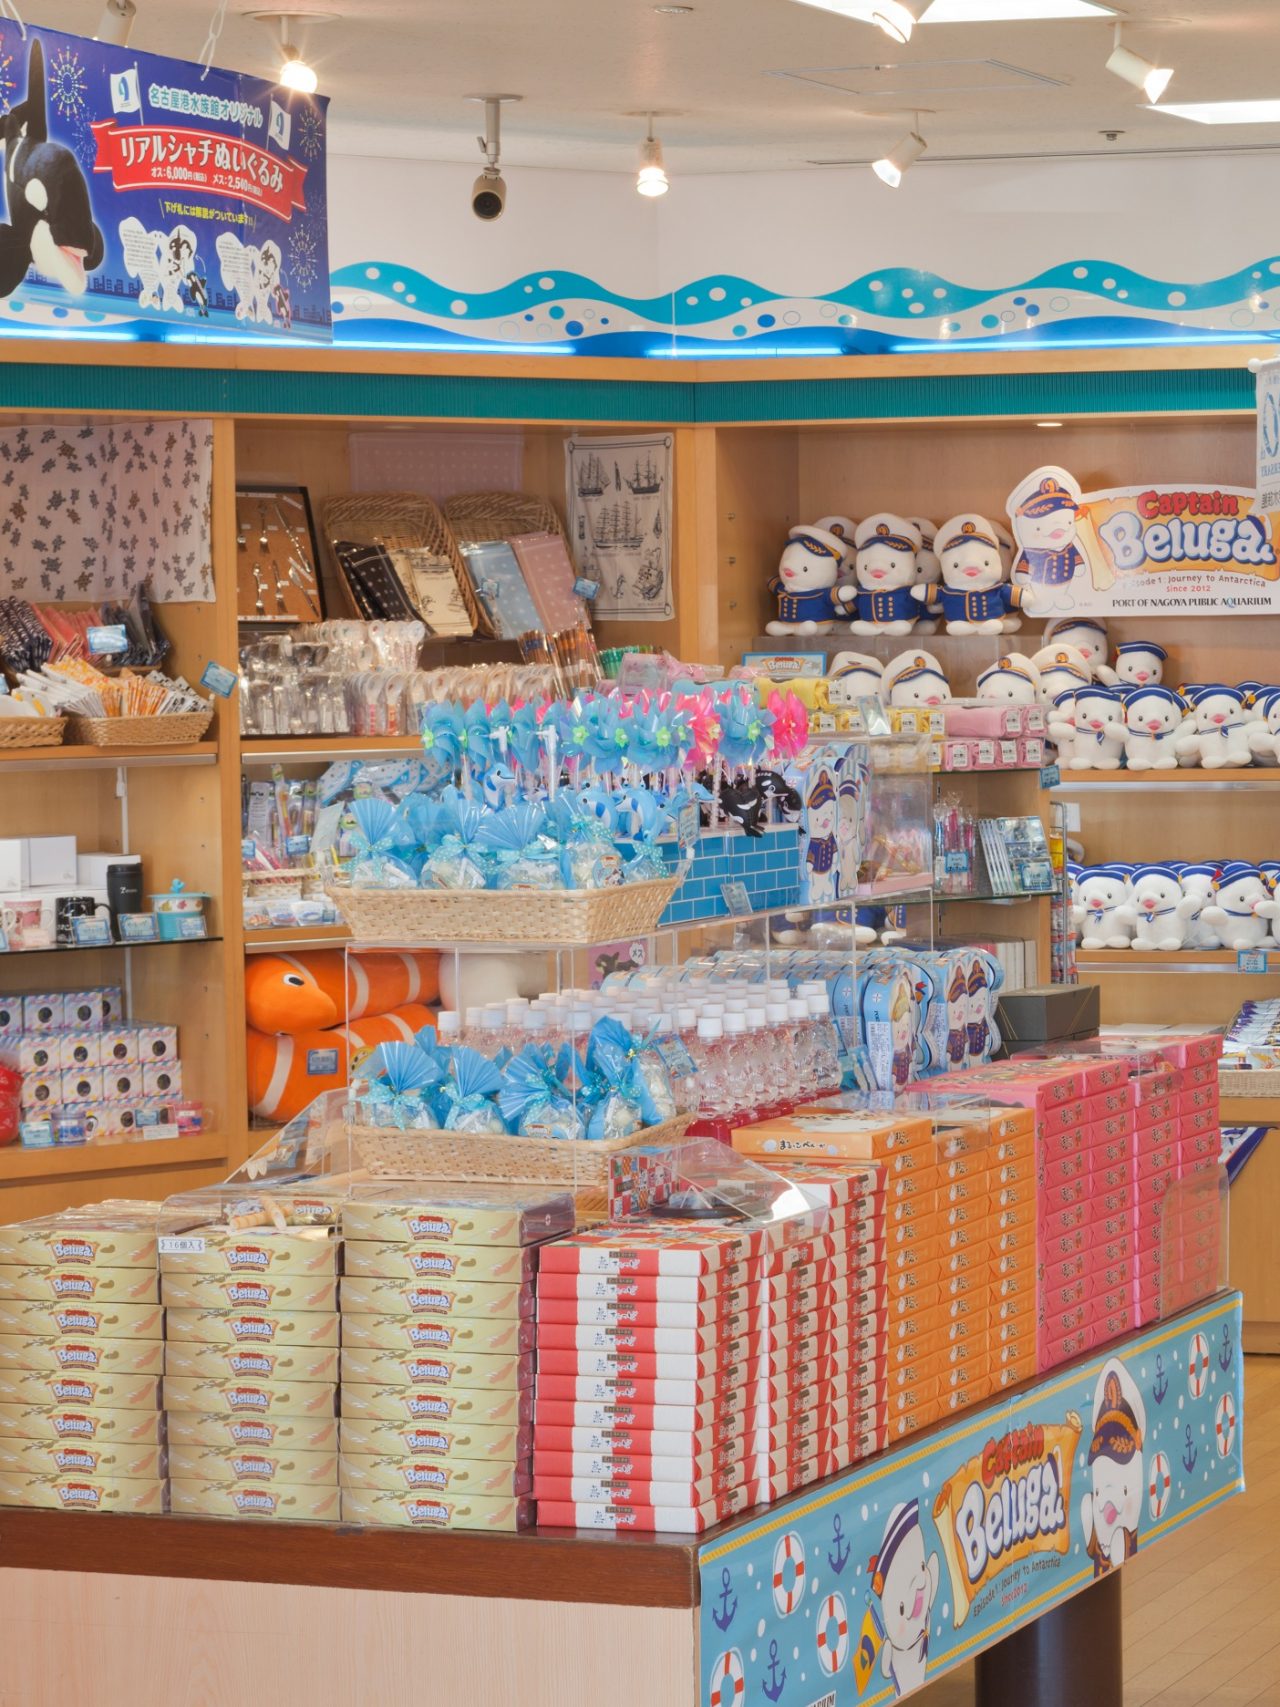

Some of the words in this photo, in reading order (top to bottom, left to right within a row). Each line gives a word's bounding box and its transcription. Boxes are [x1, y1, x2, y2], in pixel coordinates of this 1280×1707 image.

[149, 83, 263, 128] 名古屋港水族館オリジナル
[120, 135, 284, 192] リアルシャチぬいぐるみ
[1137, 490, 1239, 519] Captain
[1100, 512, 1277, 570] Beluga
[1112, 598, 1136, 607] PORT
[1137, 598, 1149, 606] OF
[1150, 598, 1187, 606] NAGOYA
[1188, 597, 1220, 606] PUBLIC
[1220, 597, 1272, 608] AQUARIUM
[1167, 575, 1202, 584] Journey
[1218, 575, 1266, 588] Antarctica
[169, 1240, 195, 1249] 16個入
[981, 1421, 1045, 1489] Captain
[956, 1457, 1067, 1585] Beluga
[973, 1588, 996, 1617] Episode
[1031, 1556, 1061, 1573] Antarctica
